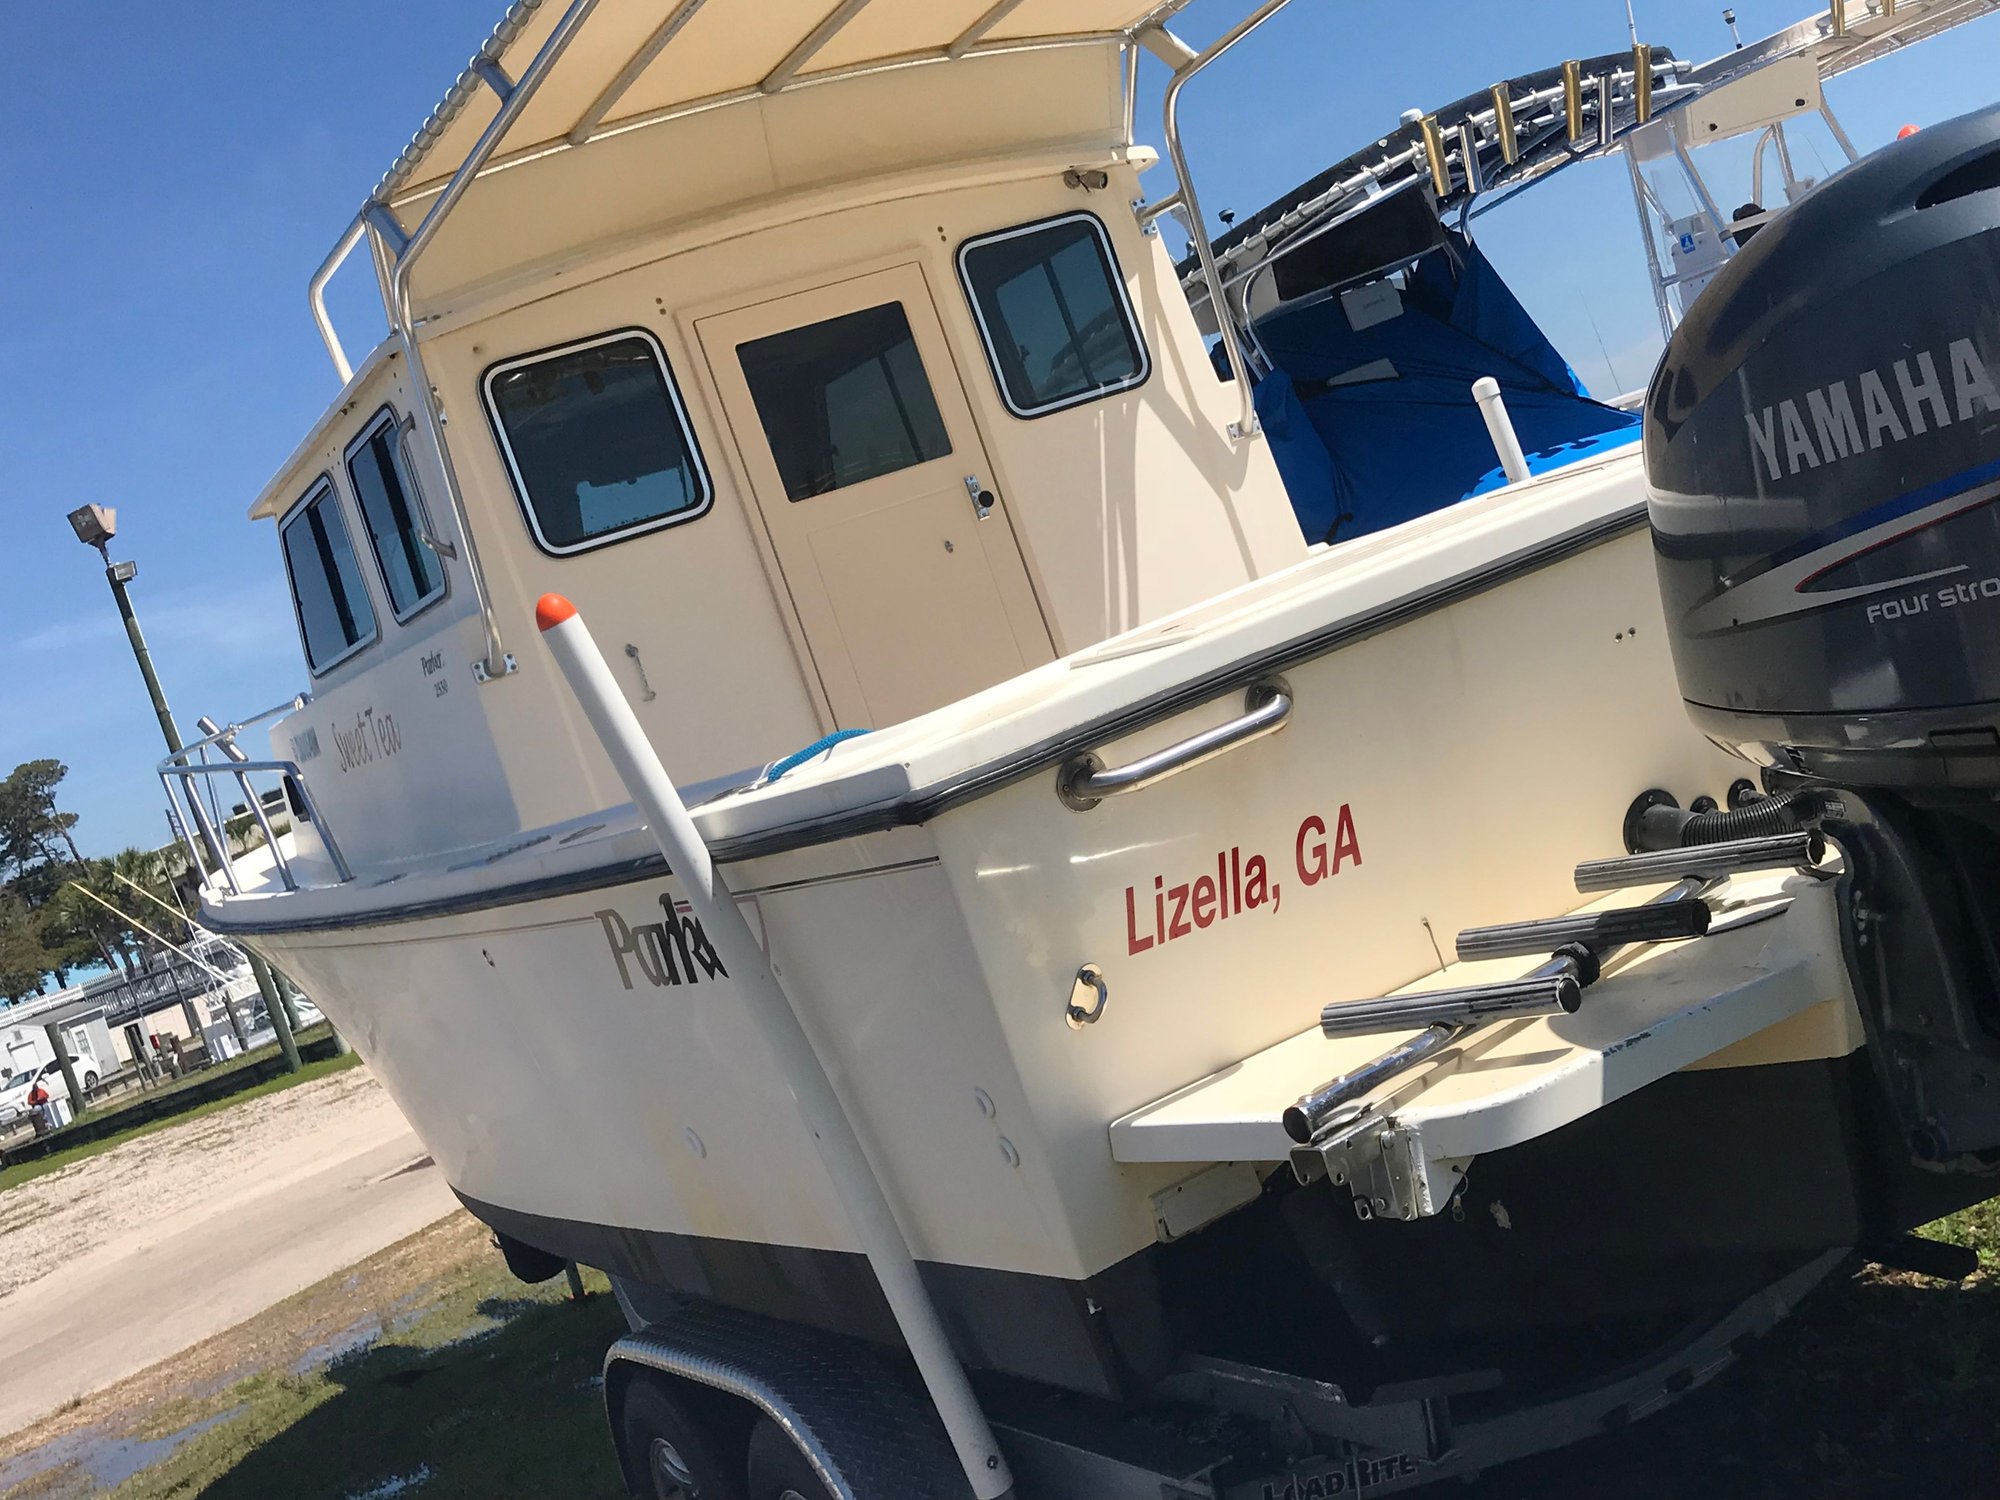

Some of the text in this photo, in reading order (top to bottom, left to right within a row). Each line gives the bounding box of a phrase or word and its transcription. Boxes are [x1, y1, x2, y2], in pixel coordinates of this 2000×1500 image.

[1744, 337, 2000, 481] YAMAHA
[331, 712, 373, 773] Sweet
[365, 706, 402, 759] Tea
[1126, 803, 1362, 957] Lizella, GA
[594, 893, 730, 990] Park
